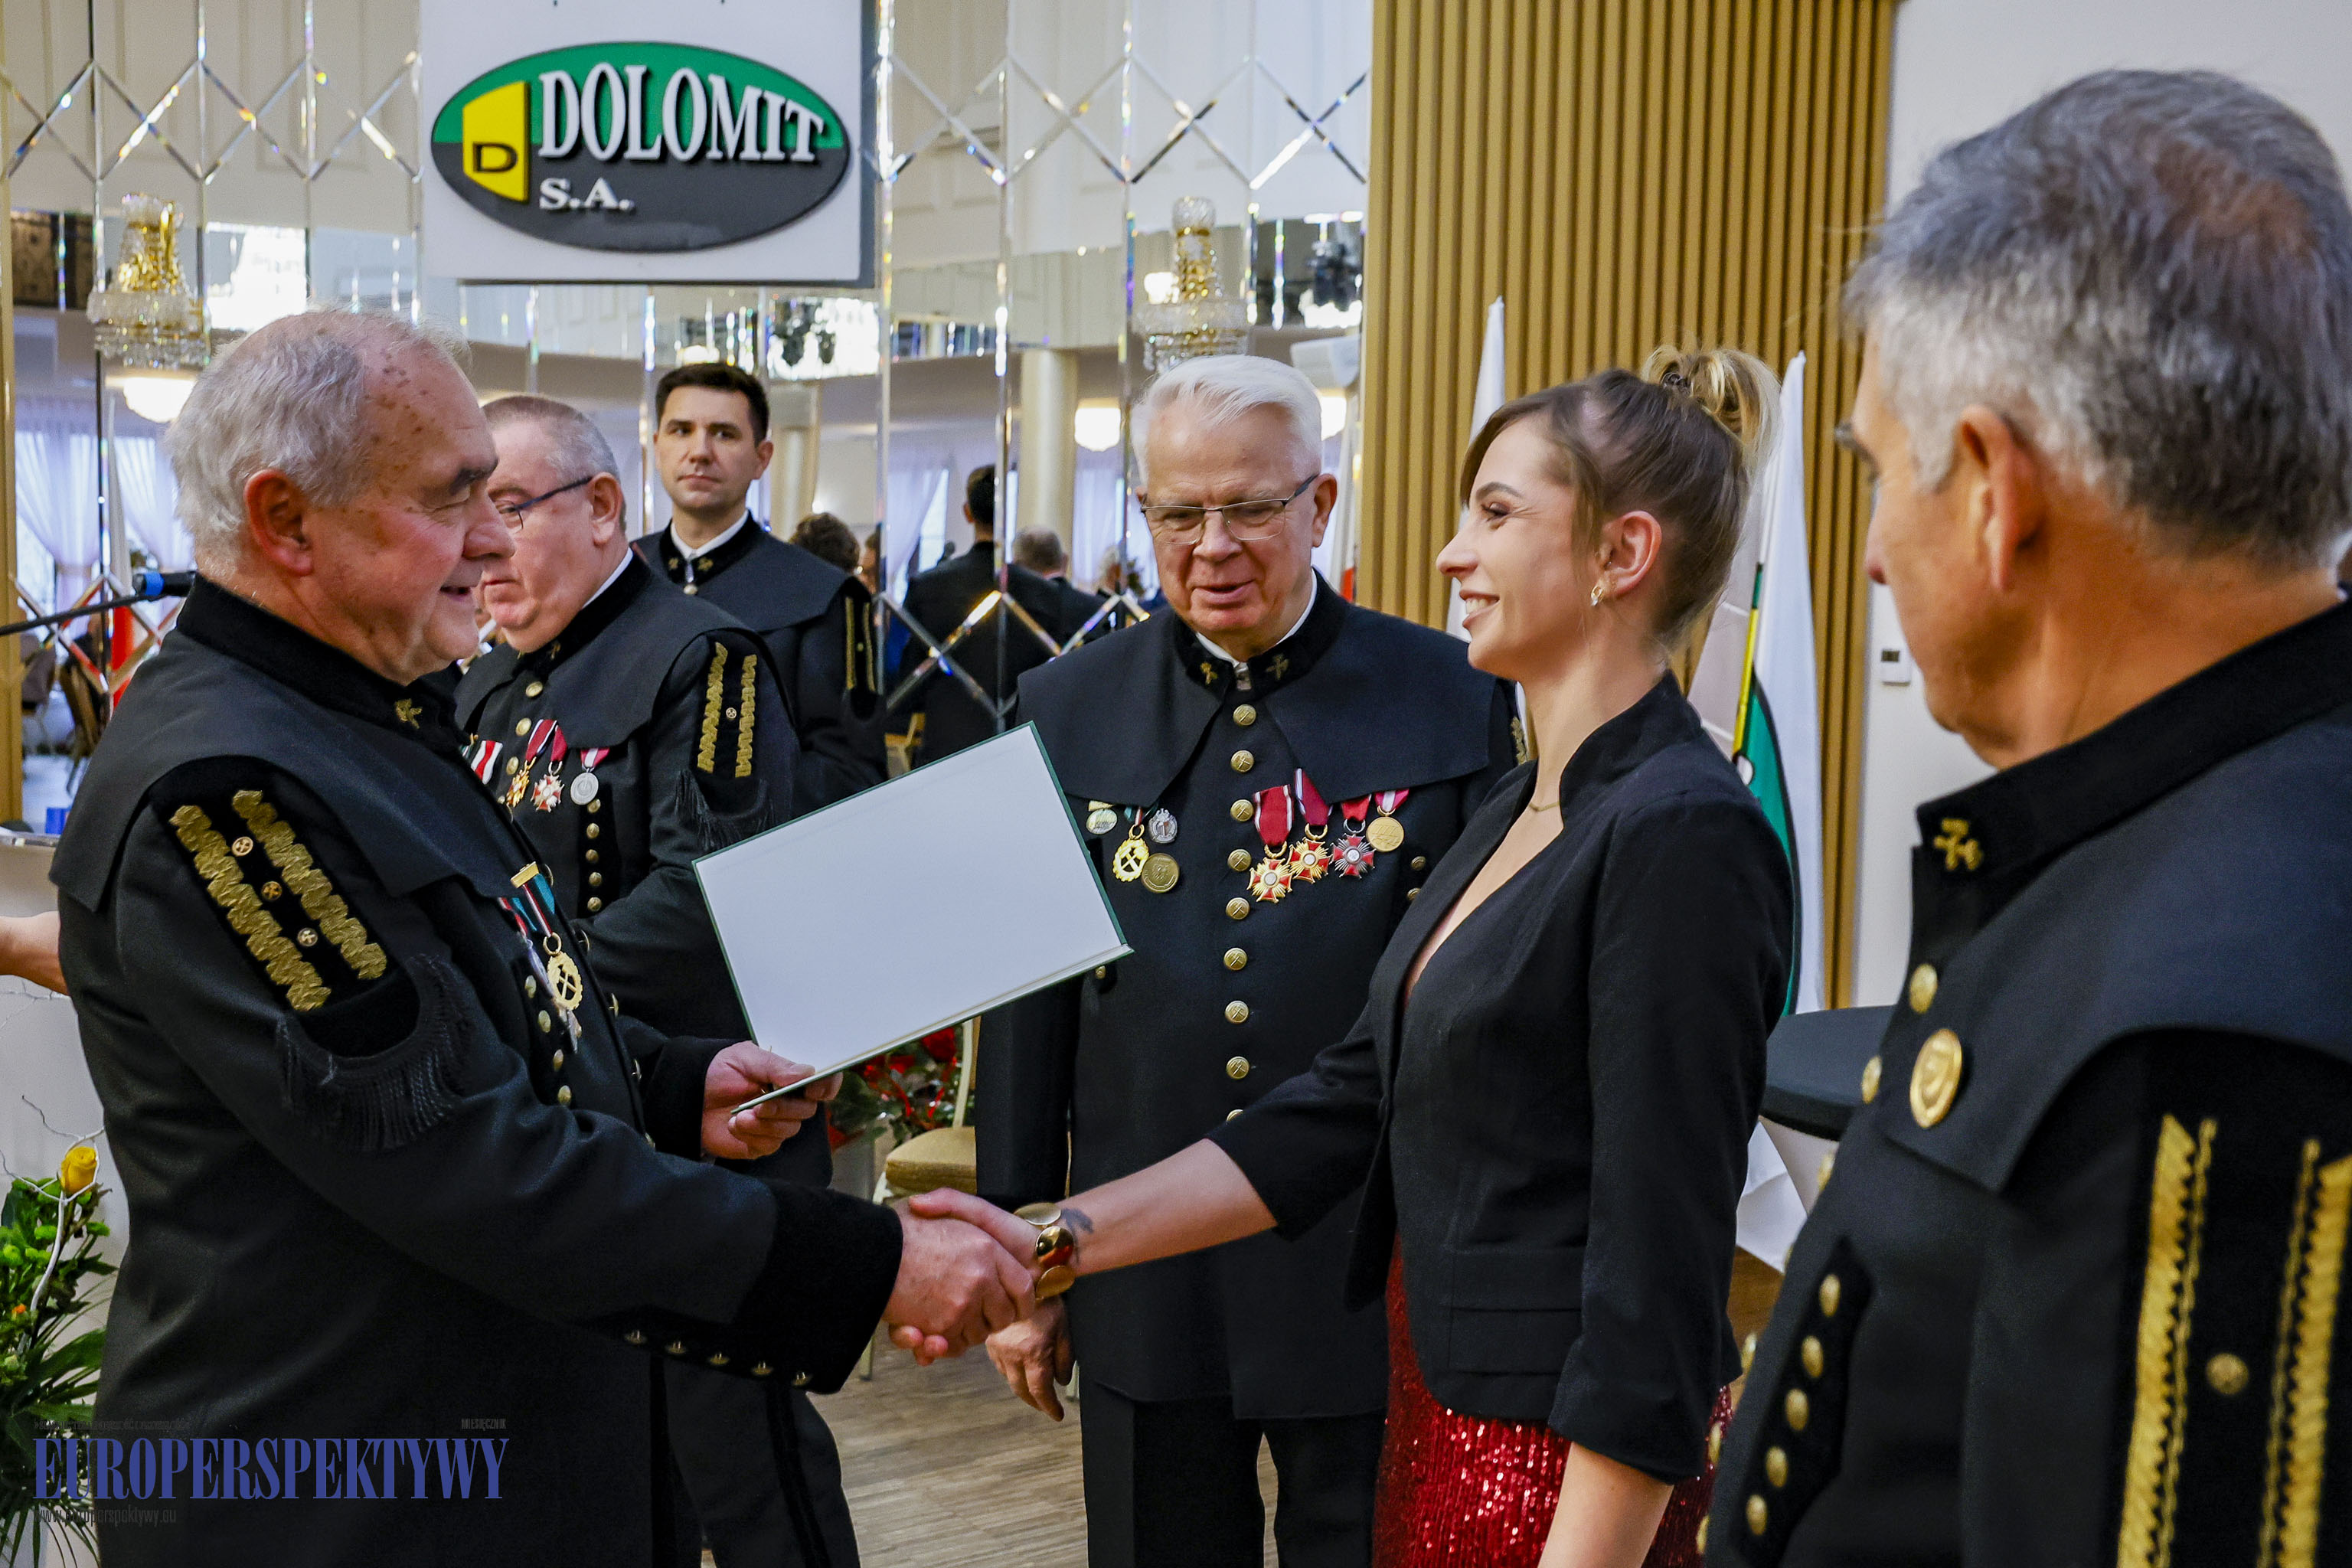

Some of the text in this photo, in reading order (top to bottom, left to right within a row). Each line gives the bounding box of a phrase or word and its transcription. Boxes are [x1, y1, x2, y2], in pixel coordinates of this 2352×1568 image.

[538, 62, 825, 162] DOLOMIT
[472, 142, 518, 173] D
[539, 177, 635, 210] S.A.
